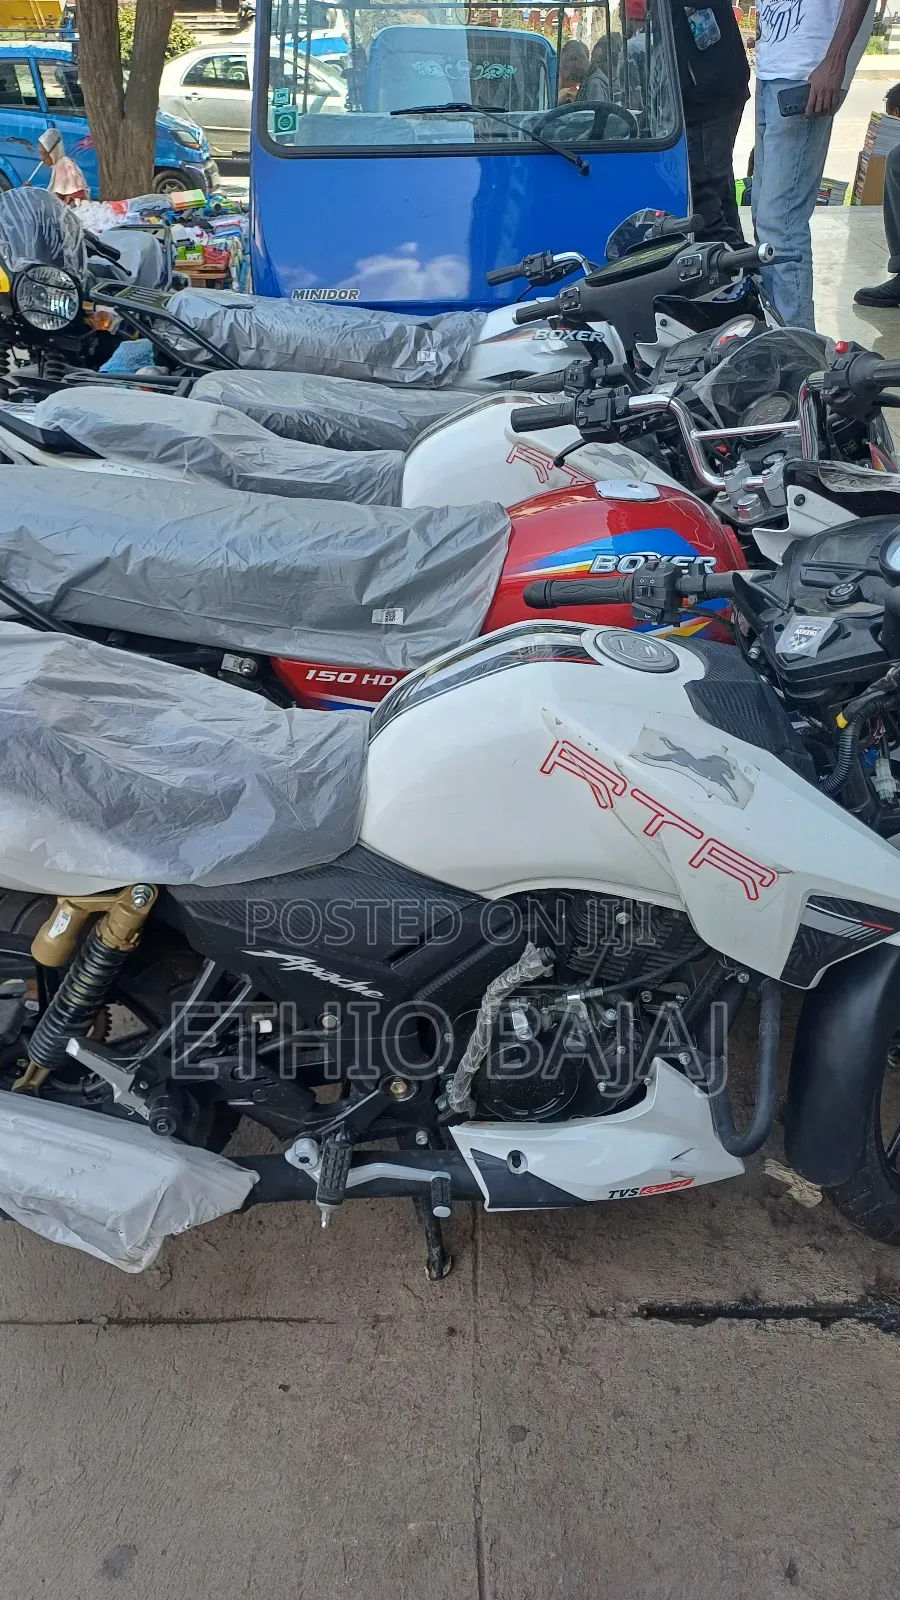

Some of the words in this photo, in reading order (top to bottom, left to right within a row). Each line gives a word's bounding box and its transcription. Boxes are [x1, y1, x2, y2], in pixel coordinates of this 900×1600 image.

[291, 288, 360, 300] MINIDOR
[533, 329, 605, 342] BOXER
[305, 669, 357, 683] 150
[361, 674, 397, 686] HD
[539, 740, 776, 901] RTR
[240, 949, 390, 1001] Apache
[608, 1187, 640, 1199] TVS
